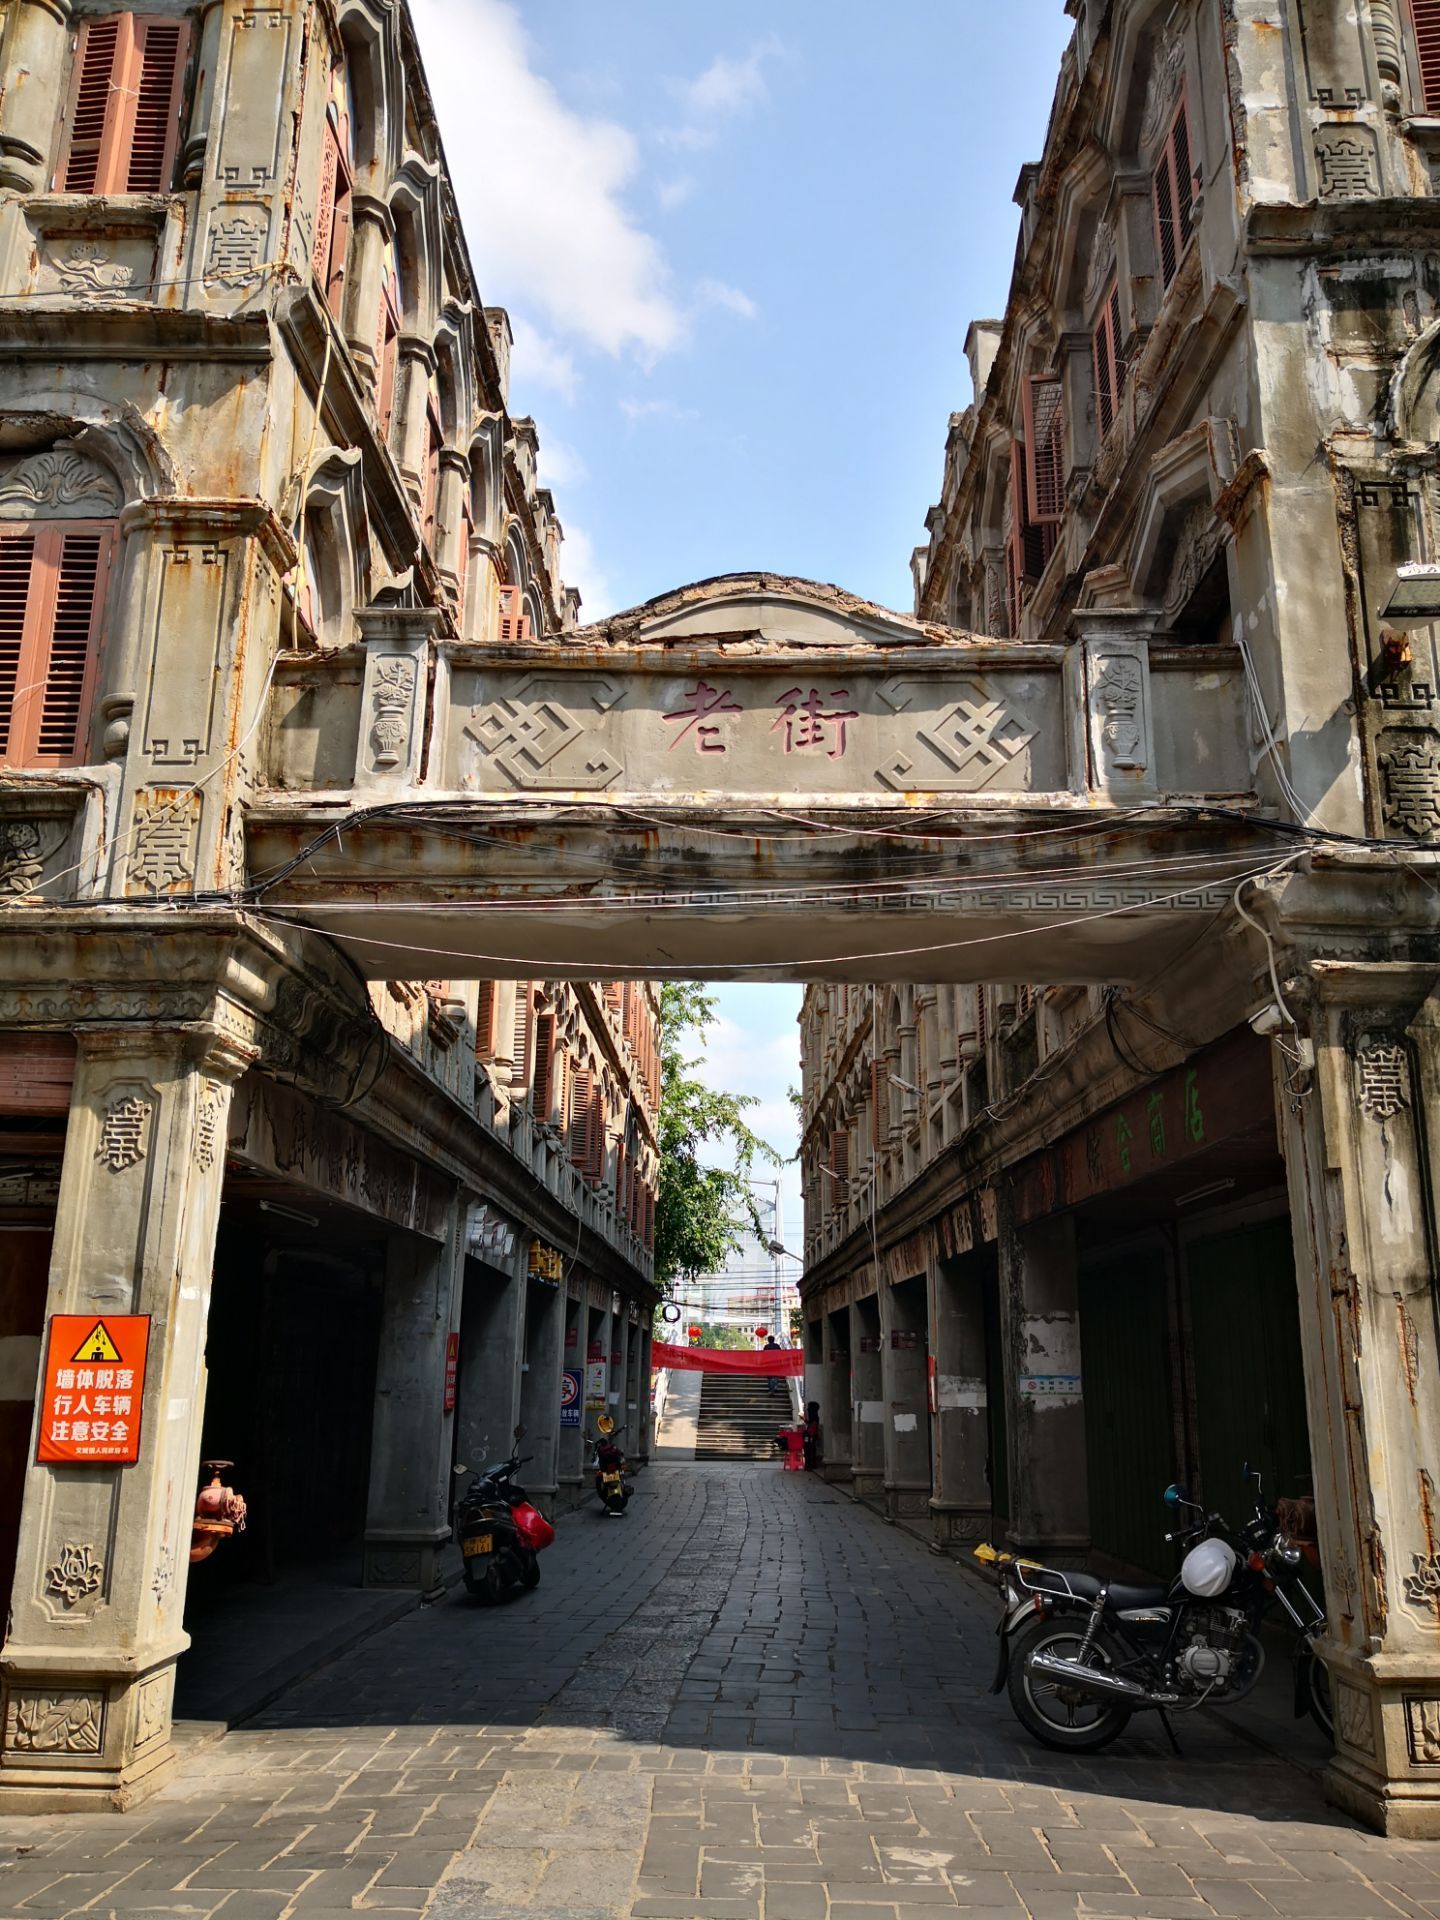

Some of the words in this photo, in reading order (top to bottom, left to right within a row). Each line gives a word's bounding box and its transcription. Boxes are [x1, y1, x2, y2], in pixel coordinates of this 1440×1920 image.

[661, 680, 859, 761] 老街
[55, 1369, 134, 1389] 墙体脱落
[53, 1395, 131, 1416] 行人车辆
[50, 1420, 129, 1442] 注意安全
